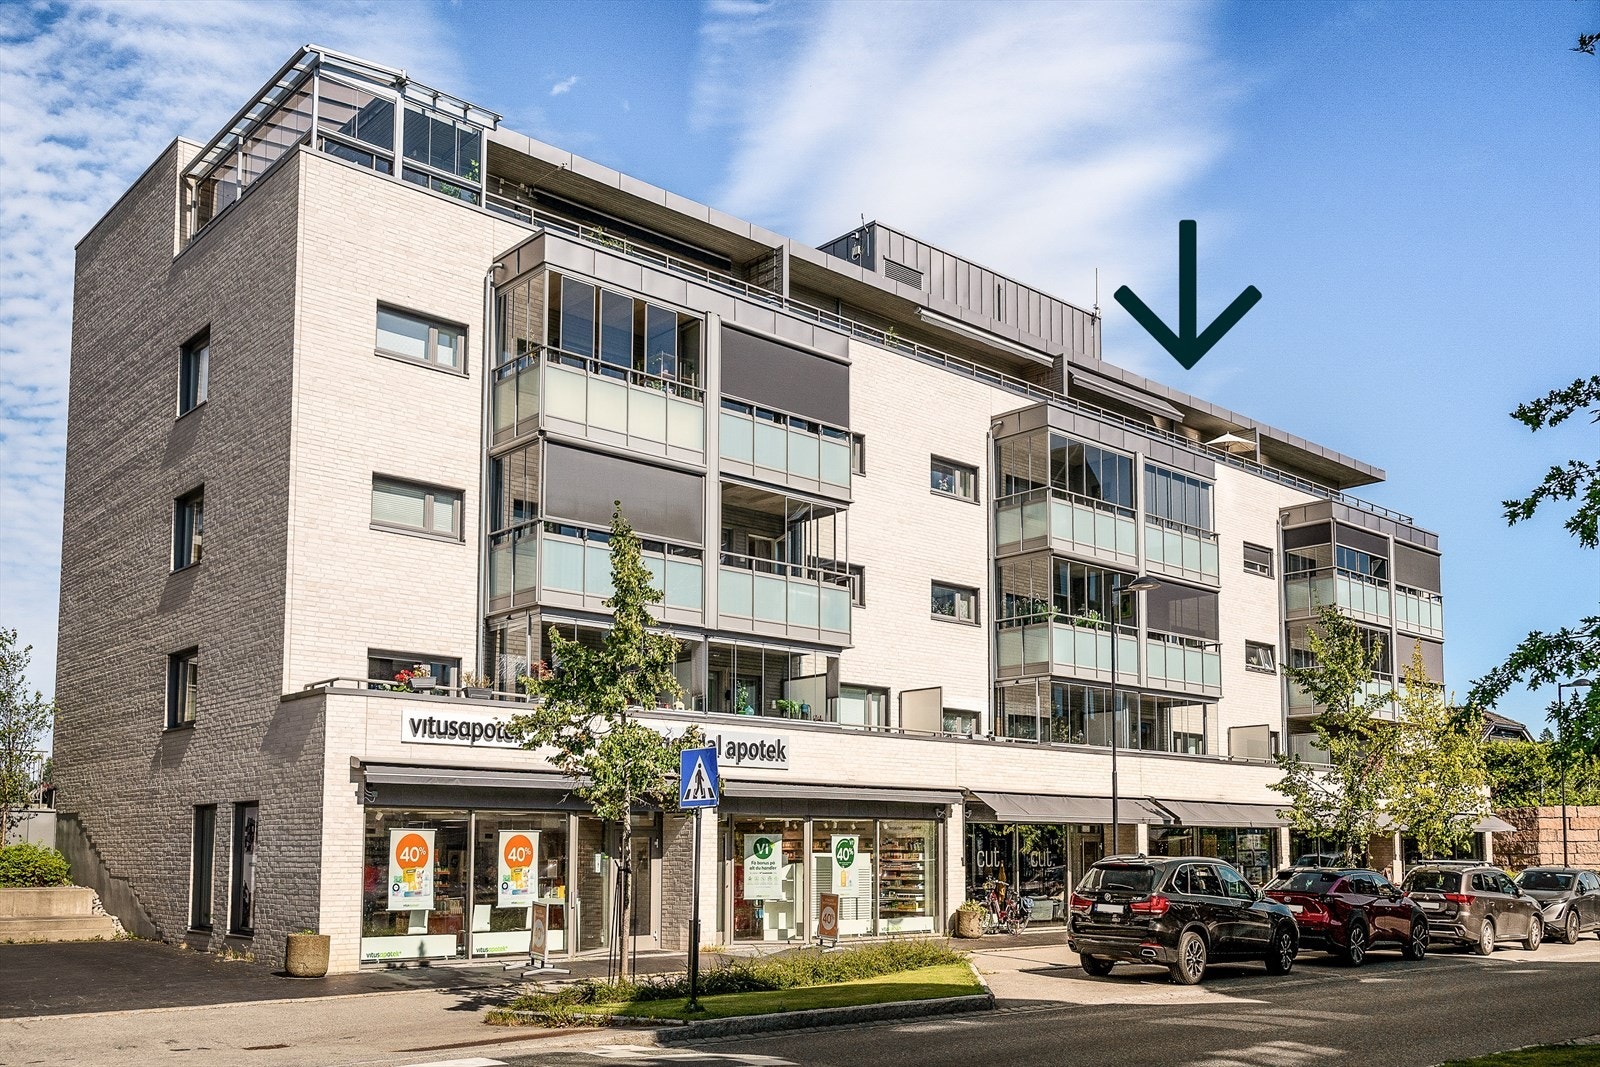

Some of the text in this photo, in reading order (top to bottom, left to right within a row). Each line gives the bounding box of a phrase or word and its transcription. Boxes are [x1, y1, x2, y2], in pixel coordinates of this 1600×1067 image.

[725, 738, 787, 763] apotek
[399, 846, 427, 862] 40%
[507, 847, 532, 862] 40%
[836, 847, 854, 861] 40%
